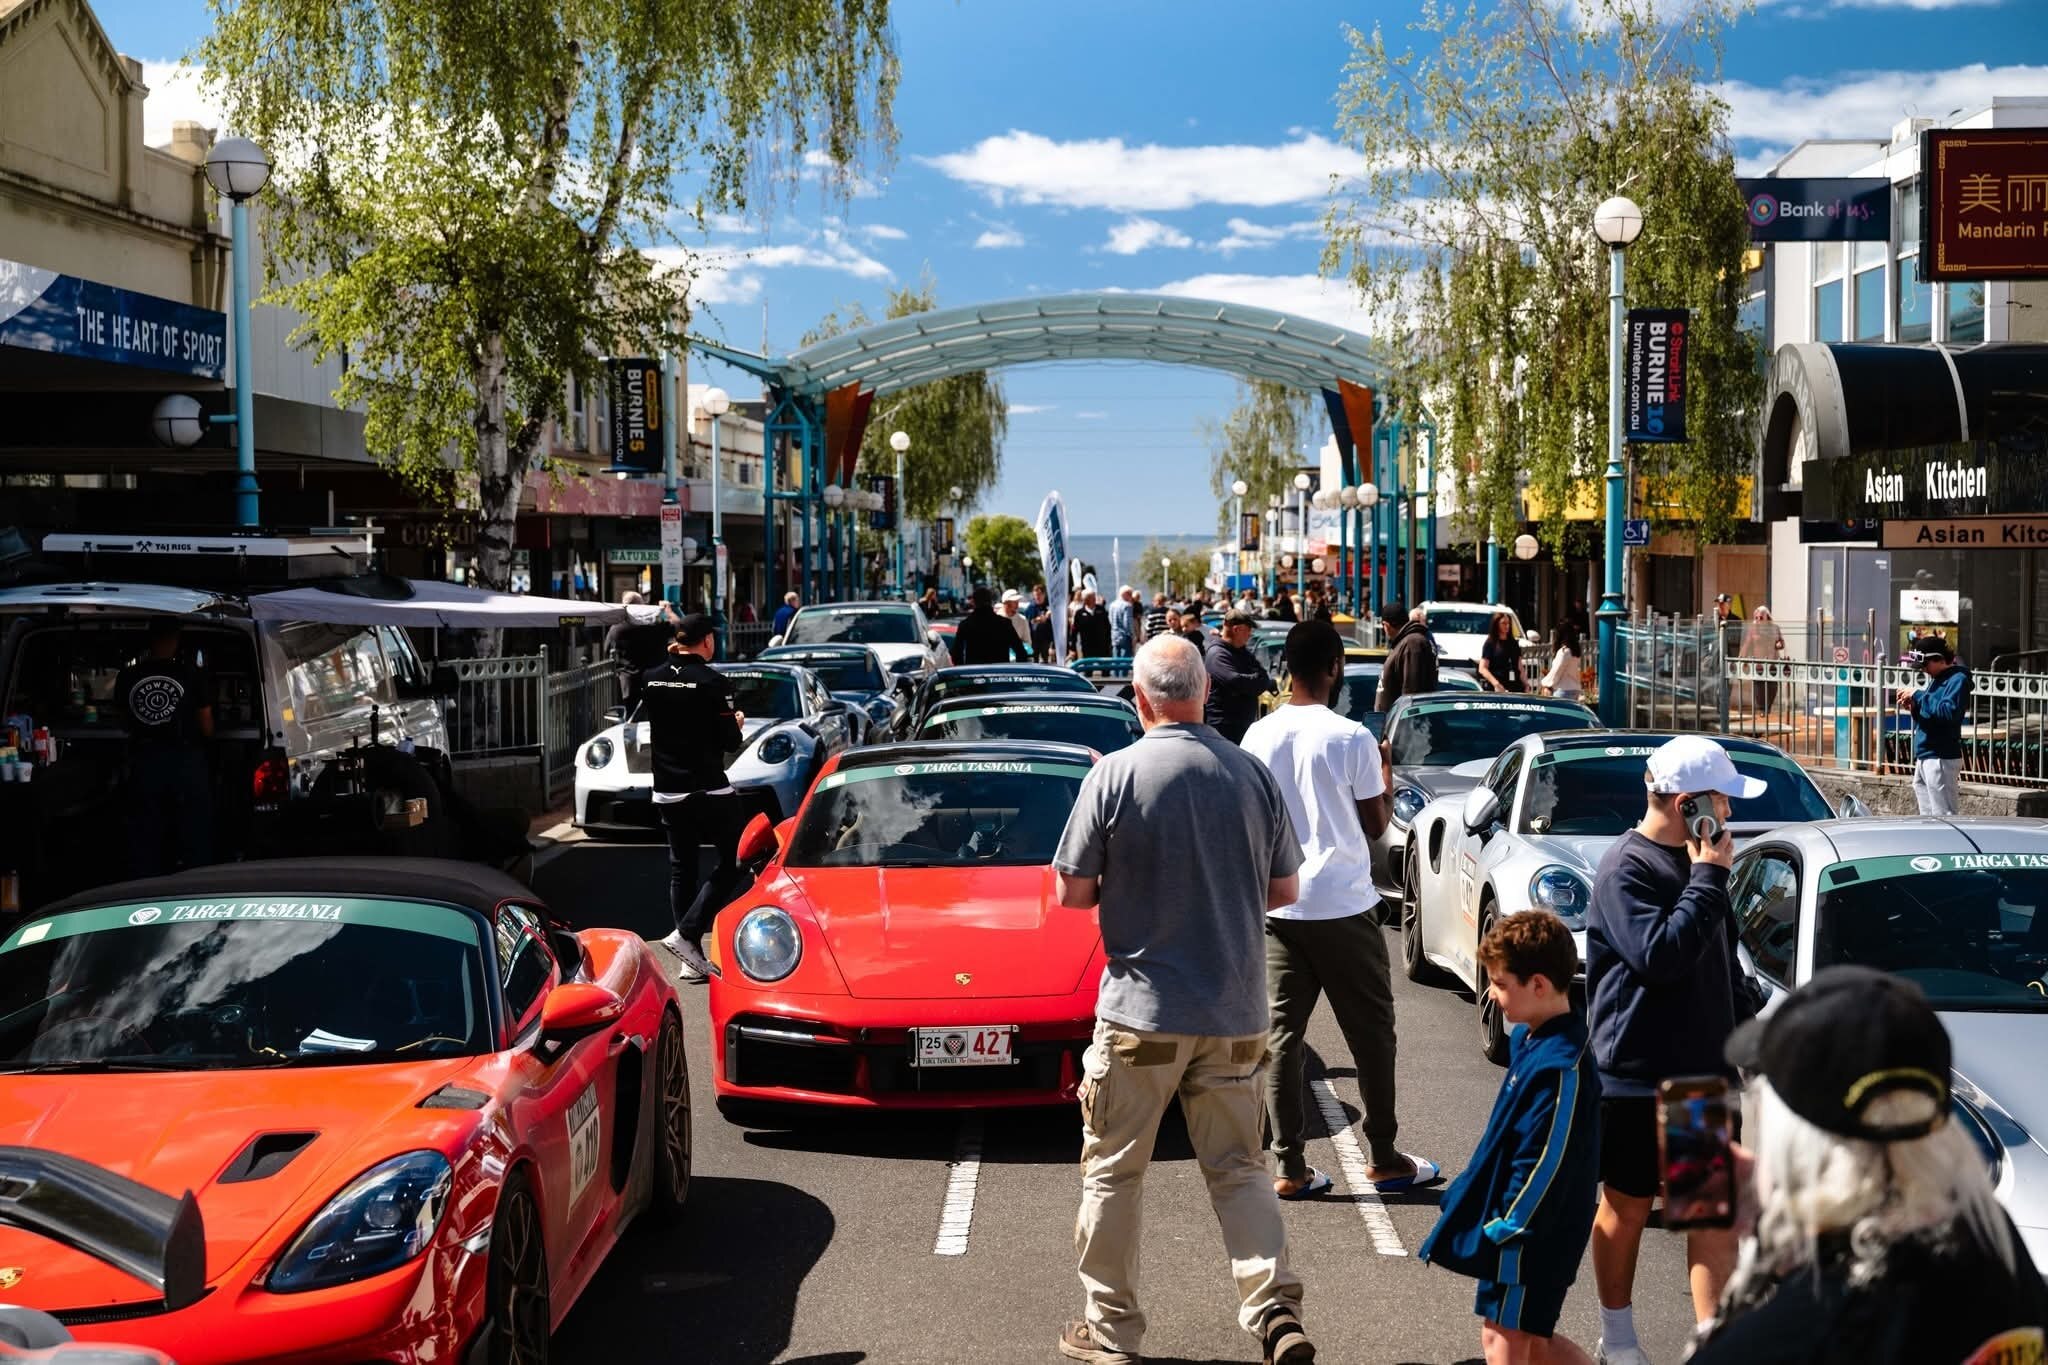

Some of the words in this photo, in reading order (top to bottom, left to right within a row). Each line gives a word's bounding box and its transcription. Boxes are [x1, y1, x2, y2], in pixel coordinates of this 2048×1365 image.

[1780, 201, 1824, 217] Bank
[1827, 198, 1842, 220] of
[1958, 222, 2036, 238] Mandarin
[76, 306, 105, 345] THE
[112, 313, 158, 355] HEART
[162, 325, 179, 358] OF
[183, 329, 222, 366] SPORT
[1631, 322, 1645, 431] burnieten.com.au
[1865, 466, 1904, 503] Asian
[1926, 459, 1987, 500] Kitchen
[1916, 525, 1984, 544] Asian
[2002, 525, 2048, 543] Kitc
[171, 543, 192, 551] RIGS
[611, 551, 660, 561] NATURES
[139, 681, 175, 694] POWER
[648, 681, 697, 689] PORSCHE
[1001, 705, 1032, 714] TARGA
[1033, 705, 1080, 714] TASMANIA
[1472, 702, 1501, 710] TARGA
[1501, 703, 1546, 712] TASMANIA
[922, 763, 963, 773] TARGA
[966, 762, 1032, 773] TASMANIA
[1951, 854, 2015, 869] TARGA
[2015, 854, 2048, 867] TAS
[169, 903, 234, 921] TARGA
[237, 903, 343, 920] TASMANIA
[973, 1031, 1012, 1055] 427
